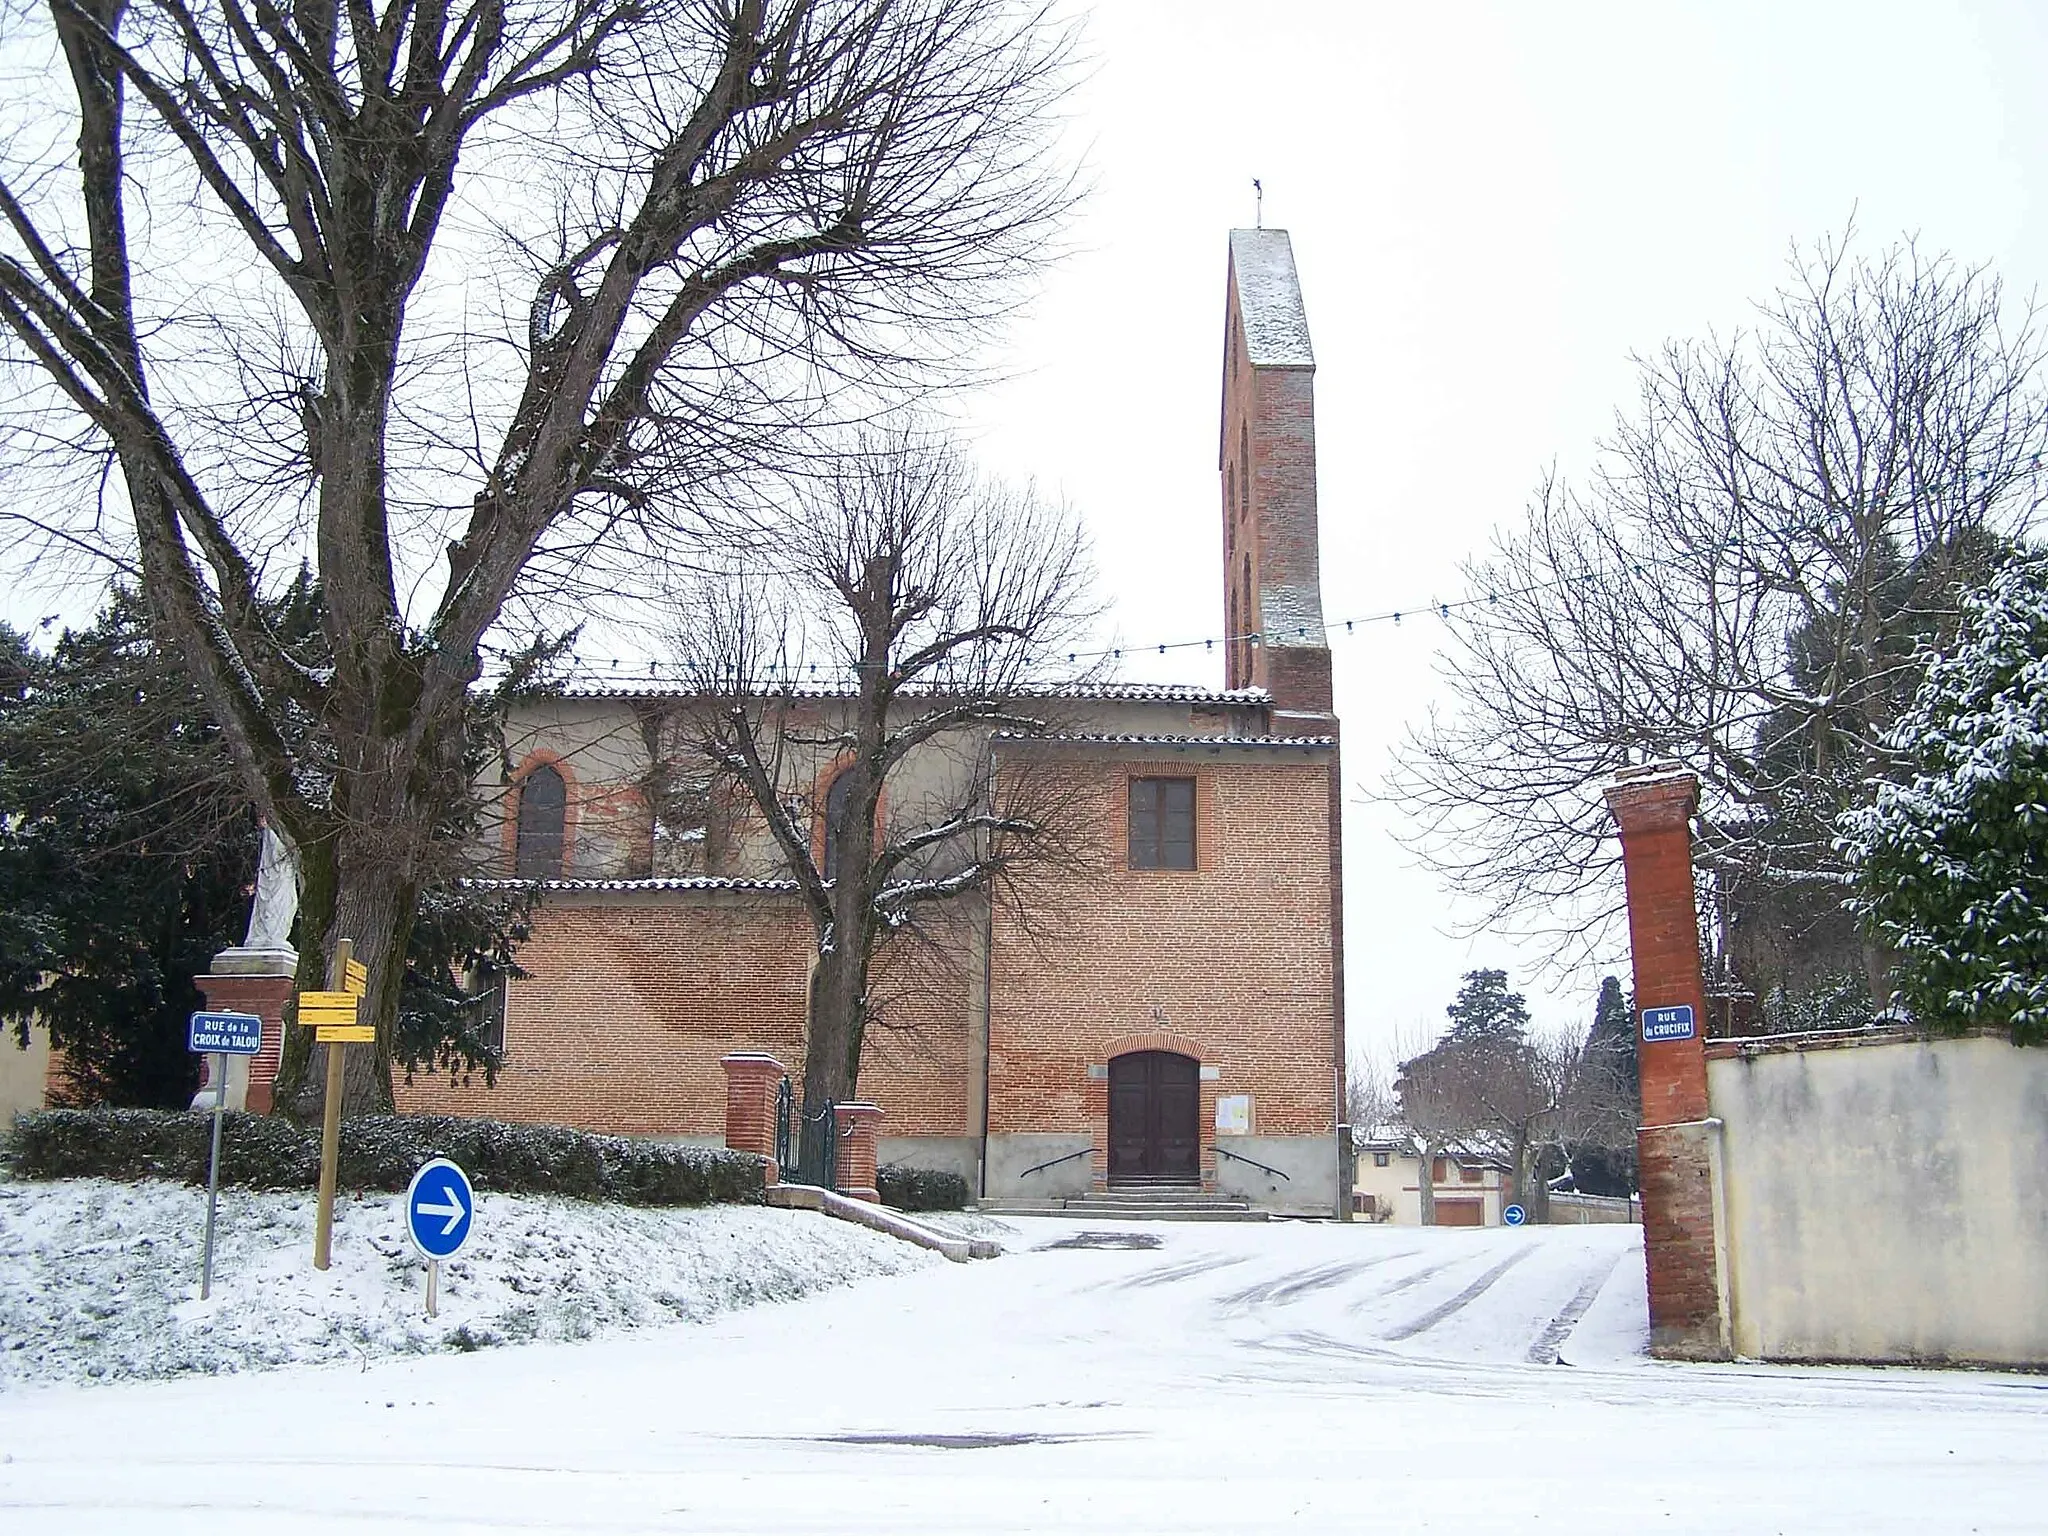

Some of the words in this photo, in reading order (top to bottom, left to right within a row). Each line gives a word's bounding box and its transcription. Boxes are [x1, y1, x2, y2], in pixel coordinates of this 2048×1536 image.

[1658, 1012, 1676, 1022] RUE
[204, 1020, 225, 1031] RUE
[227, 1022, 237, 1032] de
[240, 1023, 248, 1032] la
[1654, 1022, 1690, 1035] CRUCIFIX
[194, 1034, 220, 1046] CROIX
[221, 1035, 230, 1046] de
[232, 1036, 257, 1048] TALOU
